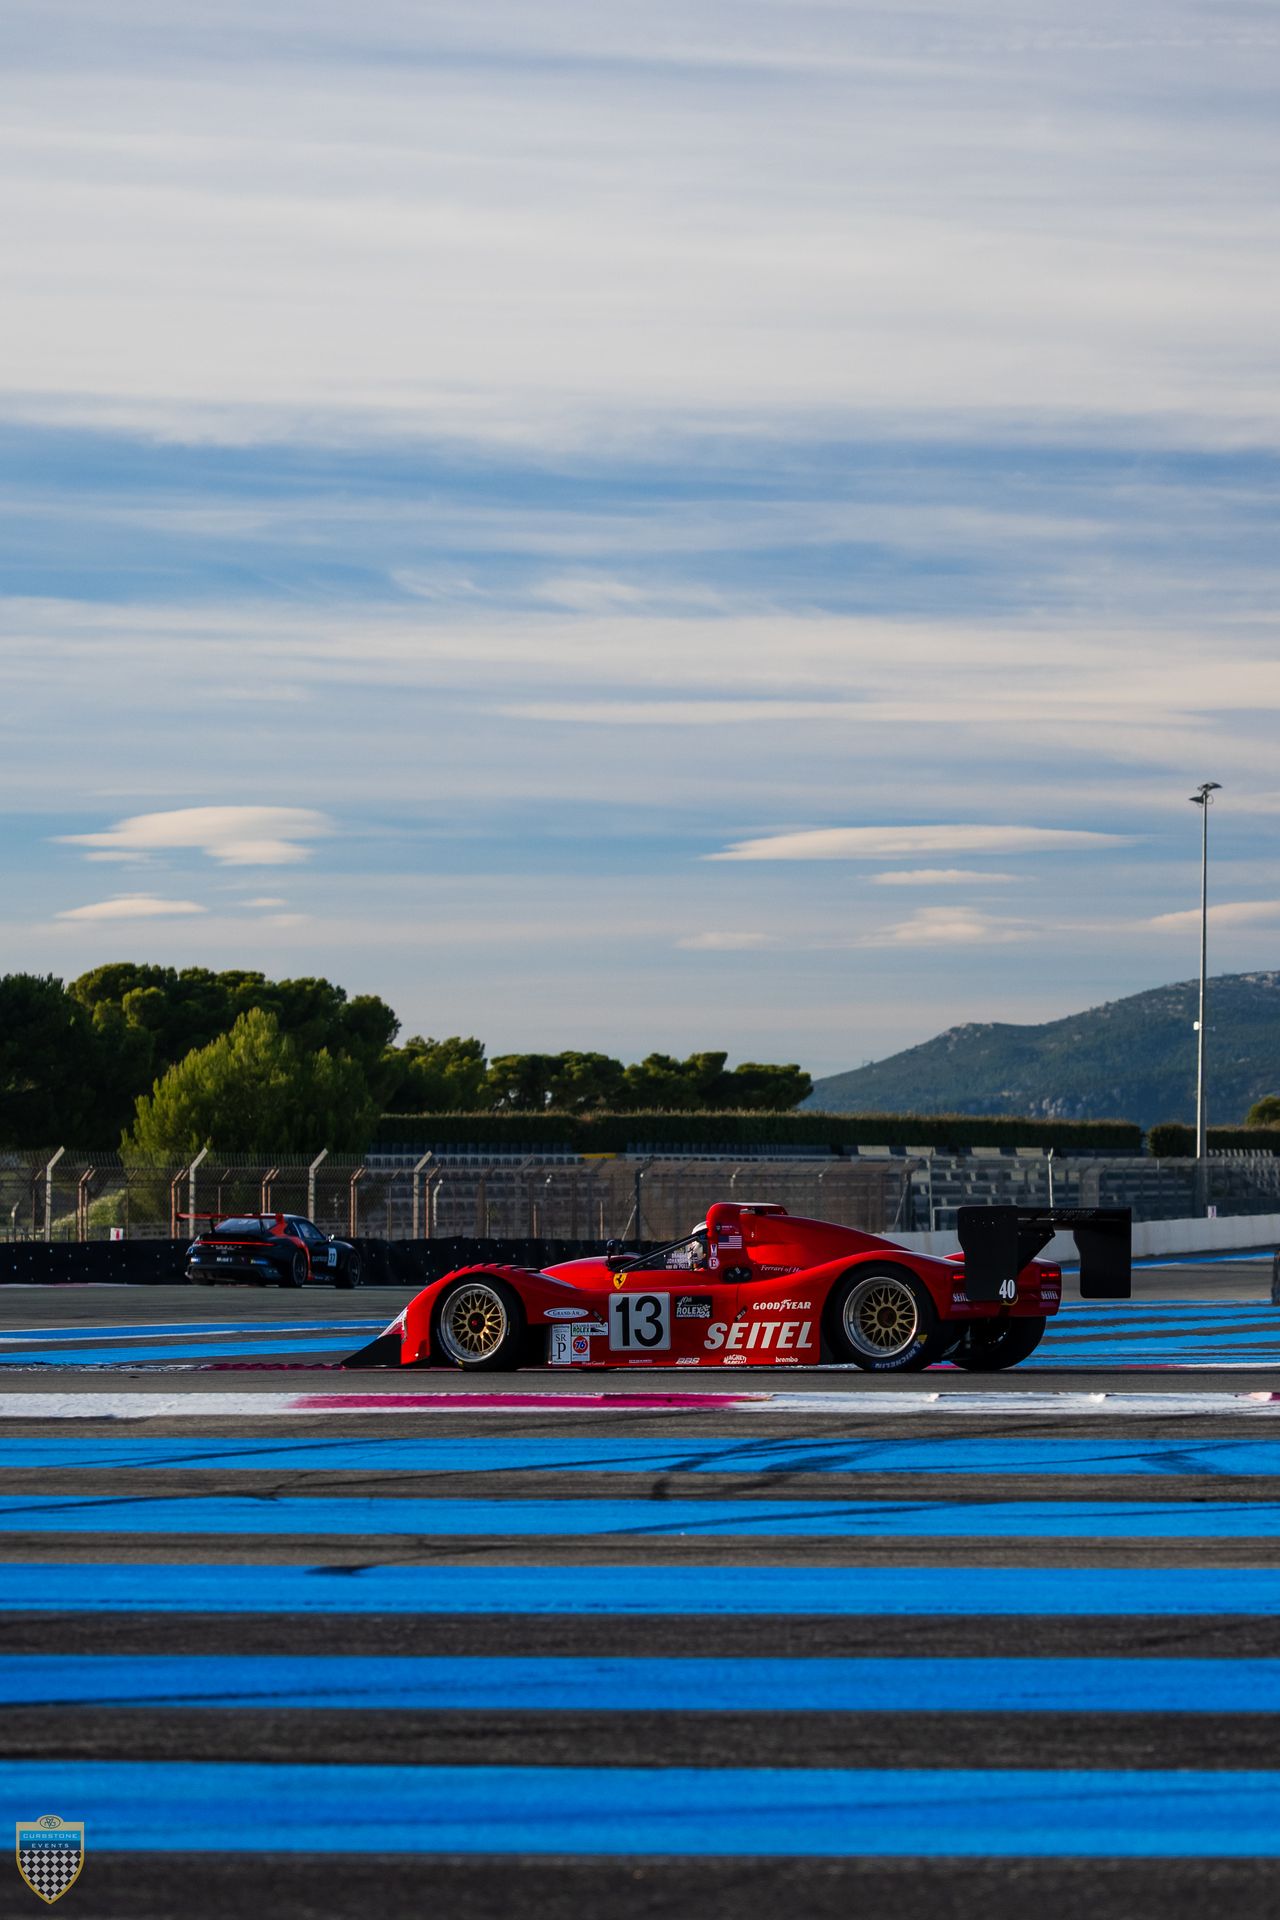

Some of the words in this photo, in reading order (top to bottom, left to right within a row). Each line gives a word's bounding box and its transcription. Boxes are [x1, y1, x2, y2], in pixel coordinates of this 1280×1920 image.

[998, 1279, 1016, 1299] 40
[616, 1296, 664, 1347] 13
[555, 1333, 566, 1342] SR
[575, 1340, 585, 1349] 76
[703, 1321, 813, 1350] SEITEL
[874, 1347, 917, 1369] MICHELIN
